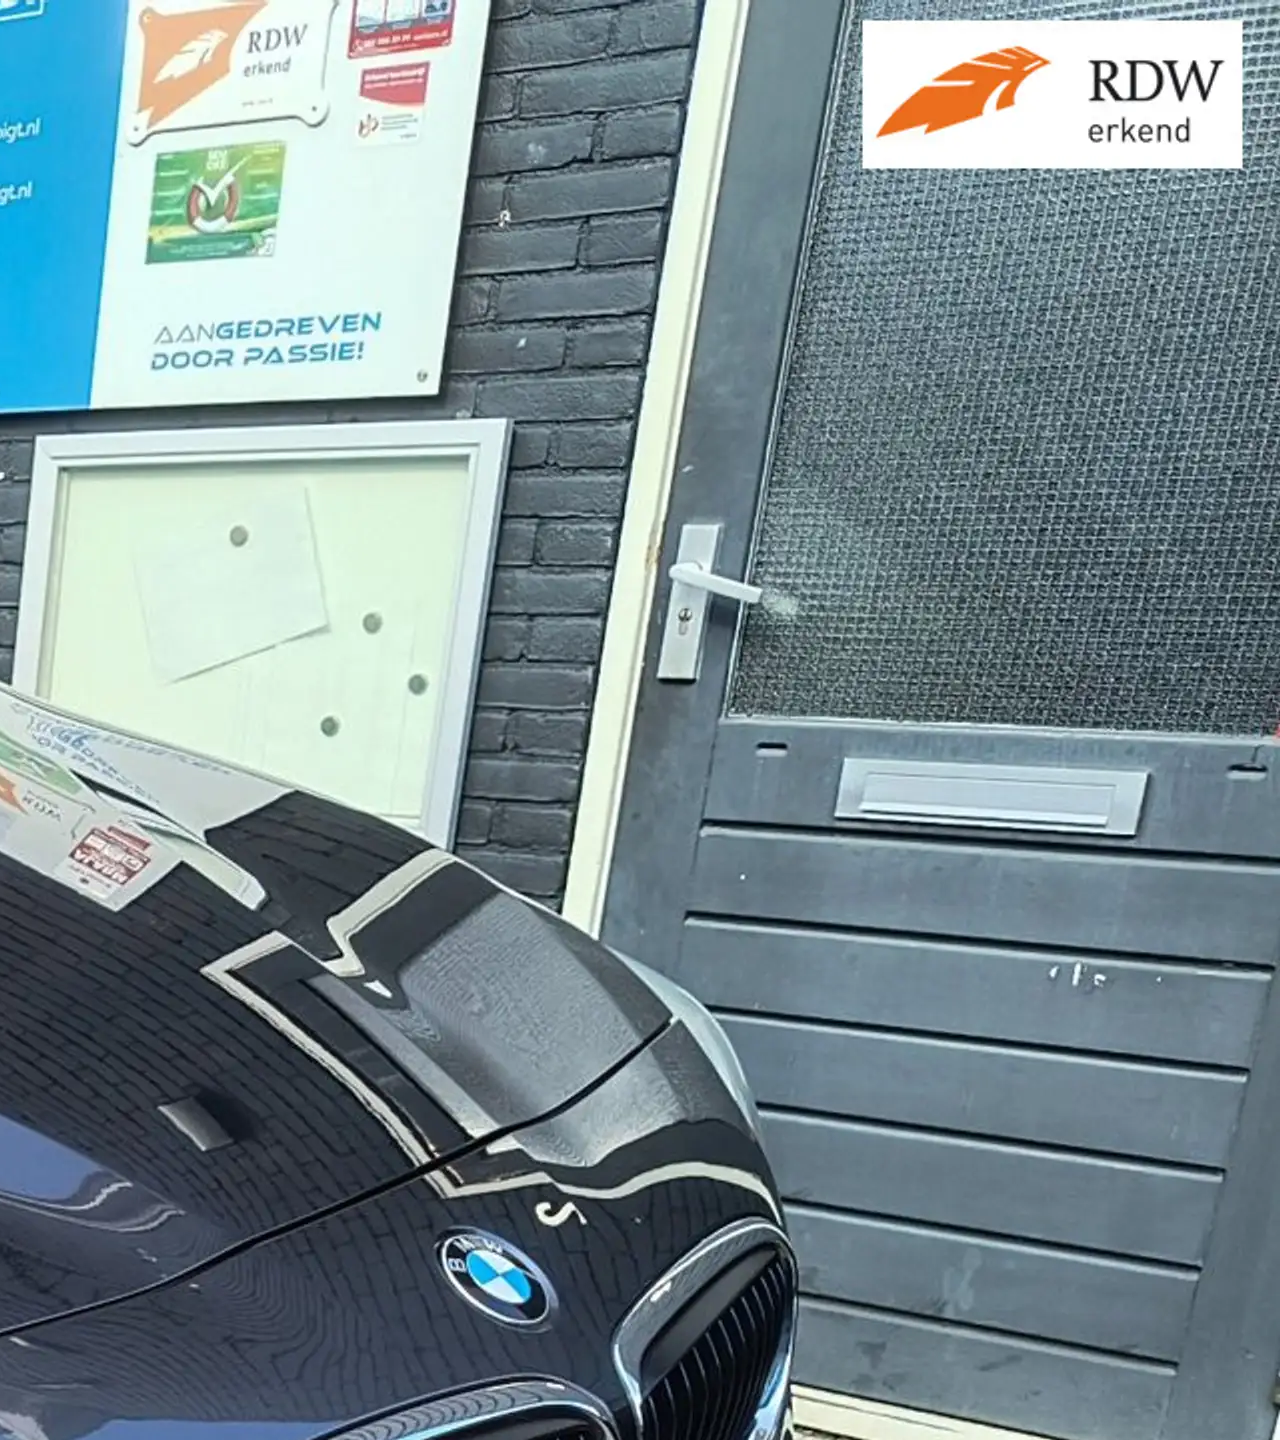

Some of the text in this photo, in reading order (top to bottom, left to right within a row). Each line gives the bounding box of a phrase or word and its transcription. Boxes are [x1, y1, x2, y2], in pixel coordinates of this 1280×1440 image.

[247, 24, 309, 54] RDW
[243, 58, 291, 78] erkend
[153, 312, 382, 344] AANGEDREVEN
[151, 341, 365, 371] DOOR PASSIE!
